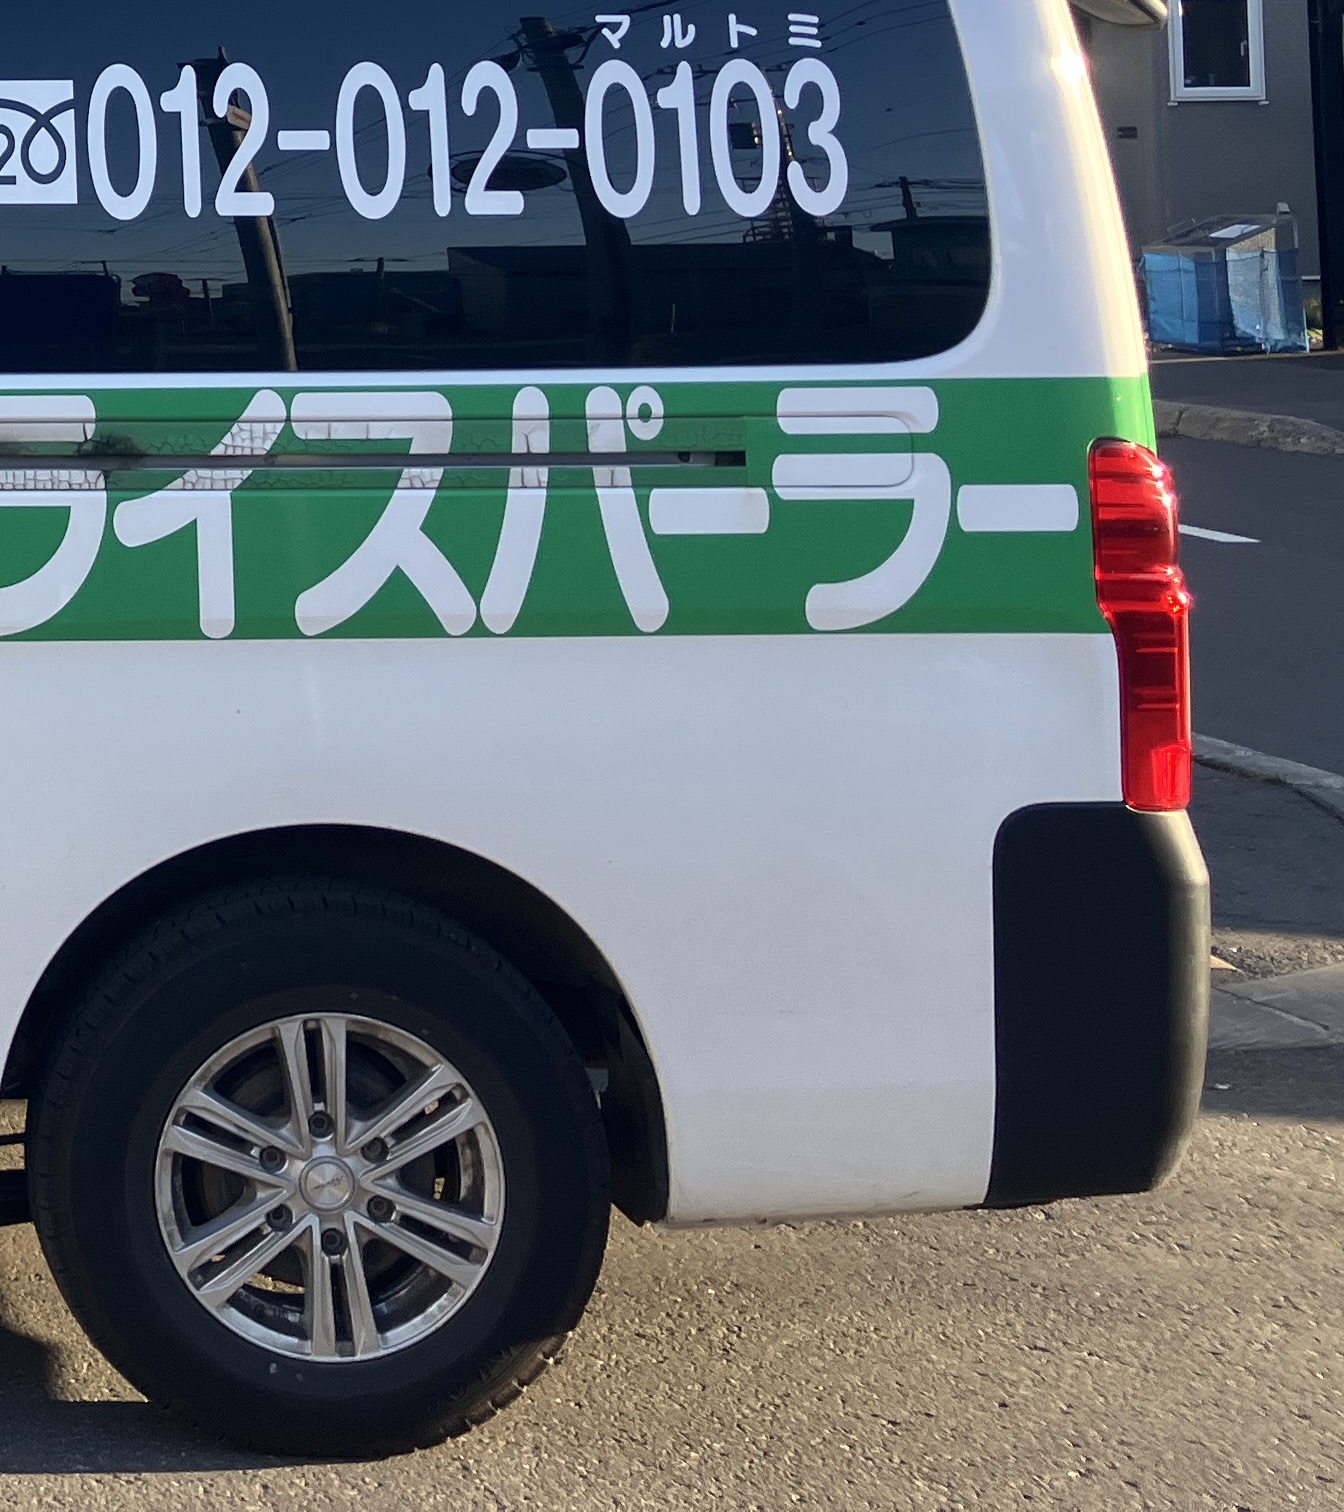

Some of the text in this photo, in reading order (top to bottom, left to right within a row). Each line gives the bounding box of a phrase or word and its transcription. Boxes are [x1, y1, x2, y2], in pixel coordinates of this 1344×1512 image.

[594, 13, 822, 49] マルトミ
[87, 57, 848, 221] 012-012-0103
